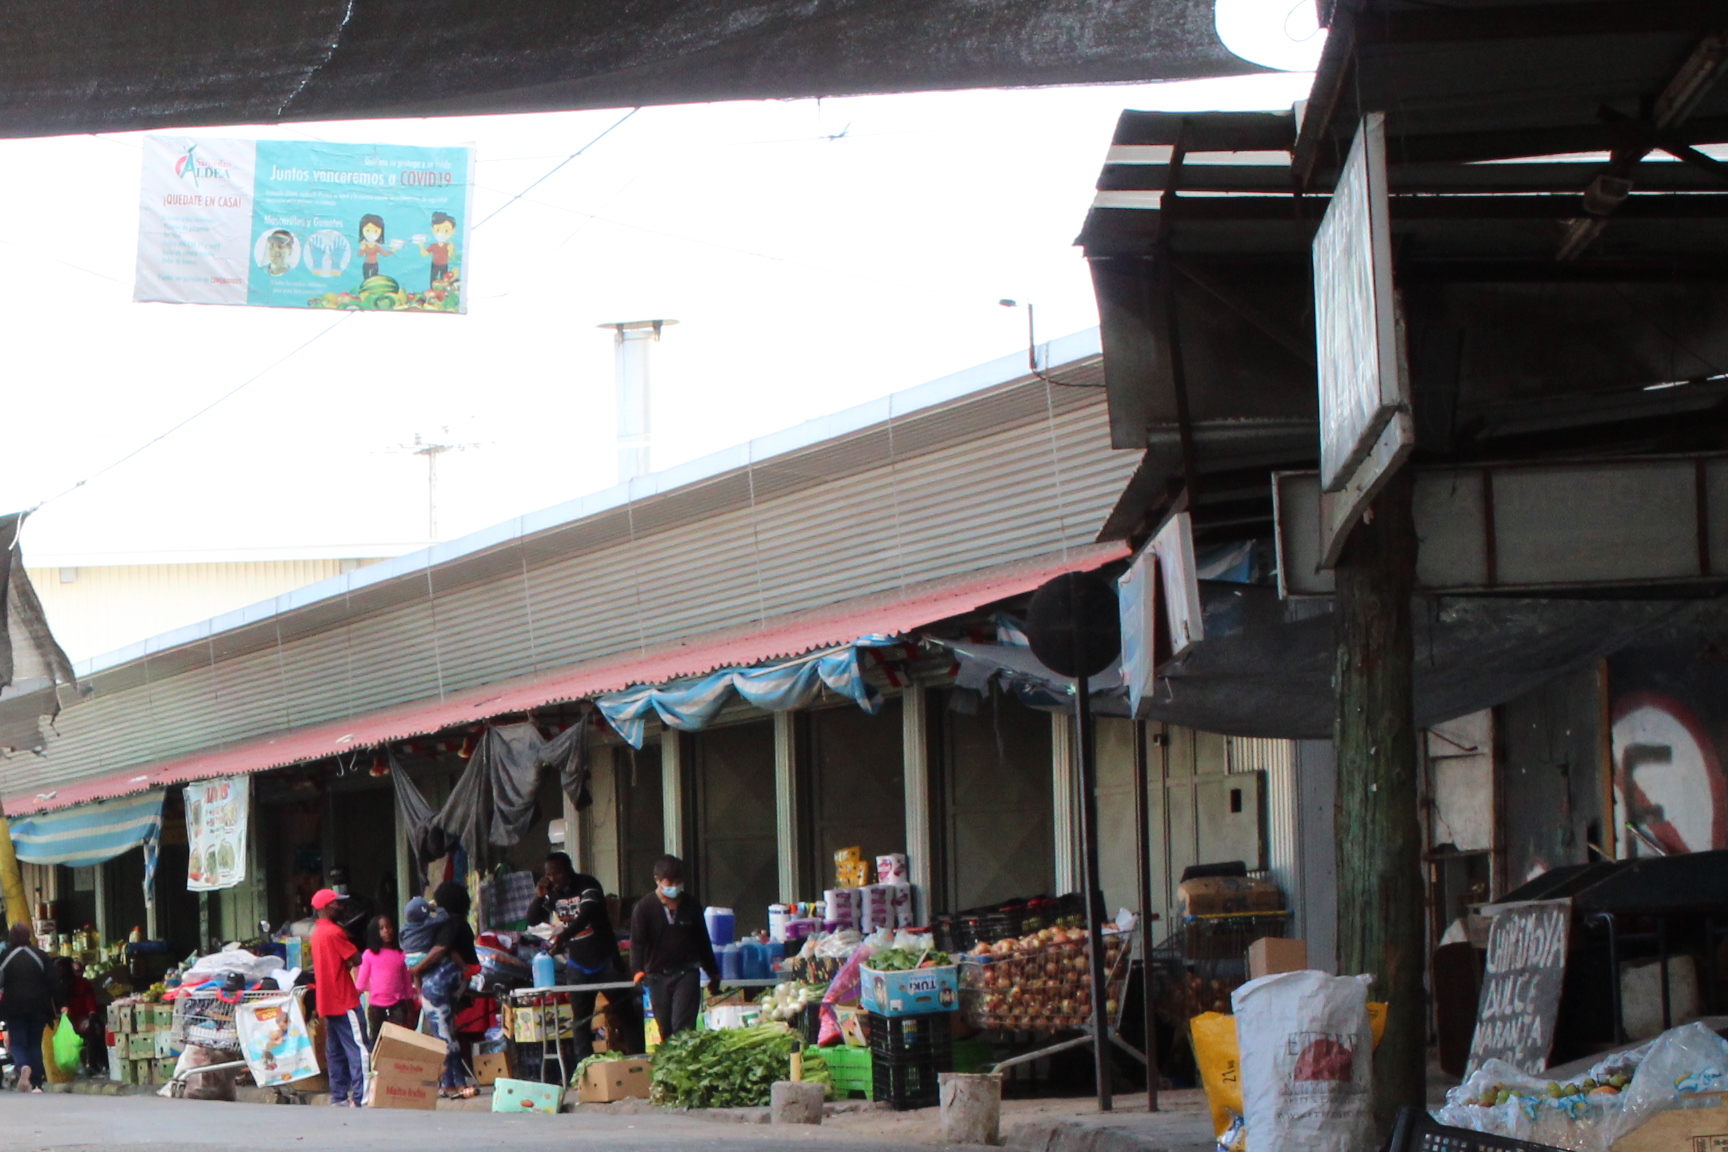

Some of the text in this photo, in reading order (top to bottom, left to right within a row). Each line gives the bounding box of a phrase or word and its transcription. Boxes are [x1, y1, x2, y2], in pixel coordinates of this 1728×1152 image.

[270, 164, 309, 181] Juntos
[313, 169, 385, 185] venceremos
[388, 173, 396, 185] a
[162, 194, 242, 208] ¡QUEDATE EN CASA!
[1482, 973, 1541, 1020] DULCE
